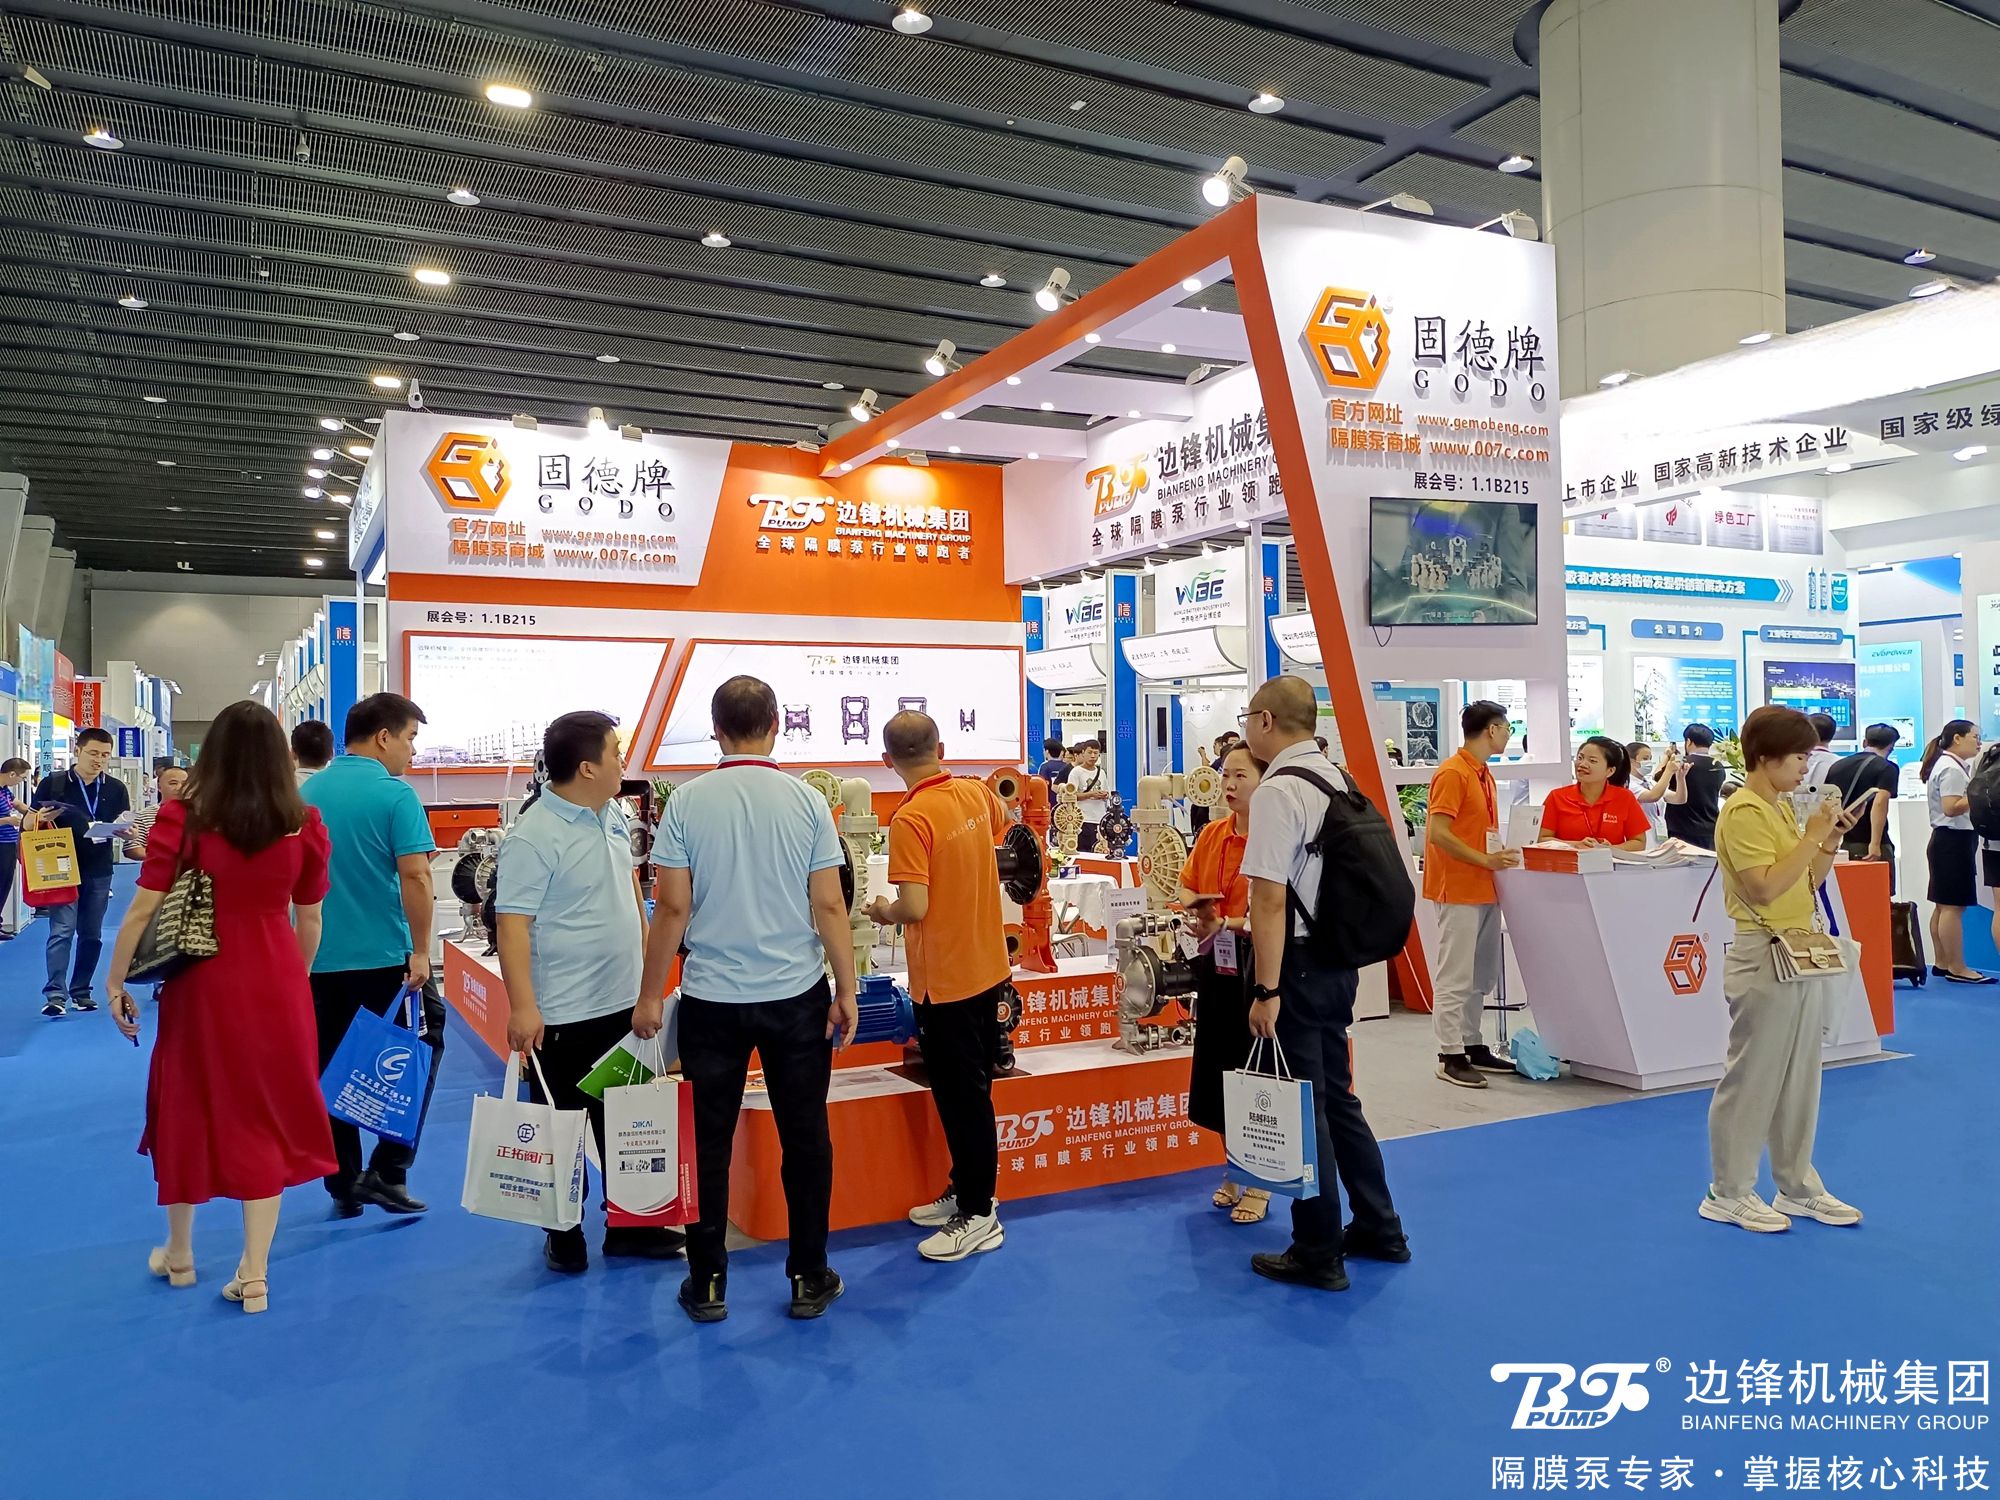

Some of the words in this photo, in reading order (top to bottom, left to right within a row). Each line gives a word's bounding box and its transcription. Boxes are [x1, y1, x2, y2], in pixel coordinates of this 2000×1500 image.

[1414, 316, 1544, 379] 固德牌
[1415, 369, 1545, 402] GODO
[1330, 399, 1403, 425] 官方网址
[1417, 413, 1549, 437] www.gemobeng.com
[1331, 428, 1421, 457] 隔膜泵商城
[1430, 440, 1549, 463] www.007c.com
[1562, 470, 1637, 502] 上市企业
[1654, 427, 1846, 482] 国家高新技术企业
[538, 454, 676, 500] 固德牌
[1158, 475, 1204, 501] BIANFENG
[1208, 455, 1269, 486] MACHINERY
[1472, 475, 1529, 495] 1.1B215
[538, 494, 674, 517] GODO
[836, 500, 970, 532] 边锋机械集团
[452, 517, 527, 538] 官方网址
[767, 519, 806, 529] PUMP
[1714, 510, 1758, 526] 绿色工厂
[542, 528, 676, 545] www.gemobeng.com
[835, 526, 881, 537] BIANFENG
[884, 529, 937, 541] MACHINERY
[940, 532, 970, 543] GROUP
[451, 538, 545, 560] 隔膜泵商城
[554, 547, 676, 565] www.007c.com
[756, 535, 970, 561] 全球隔膜泵行业领跑者
[481, 613, 536, 626] 1.1B215
[842, 655, 900, 666] 边锋机械集团
[1051, 1008, 1100, 1024] MACHINERY
[1065, 1131, 1112, 1145] BIANFENG
[1115, 1123, 1167, 1141] MACHINERY
[496, 1145, 555, 1166] 正拓阀门
[997, 1131, 1200, 1174] 球隔膜泵行业领跑者
